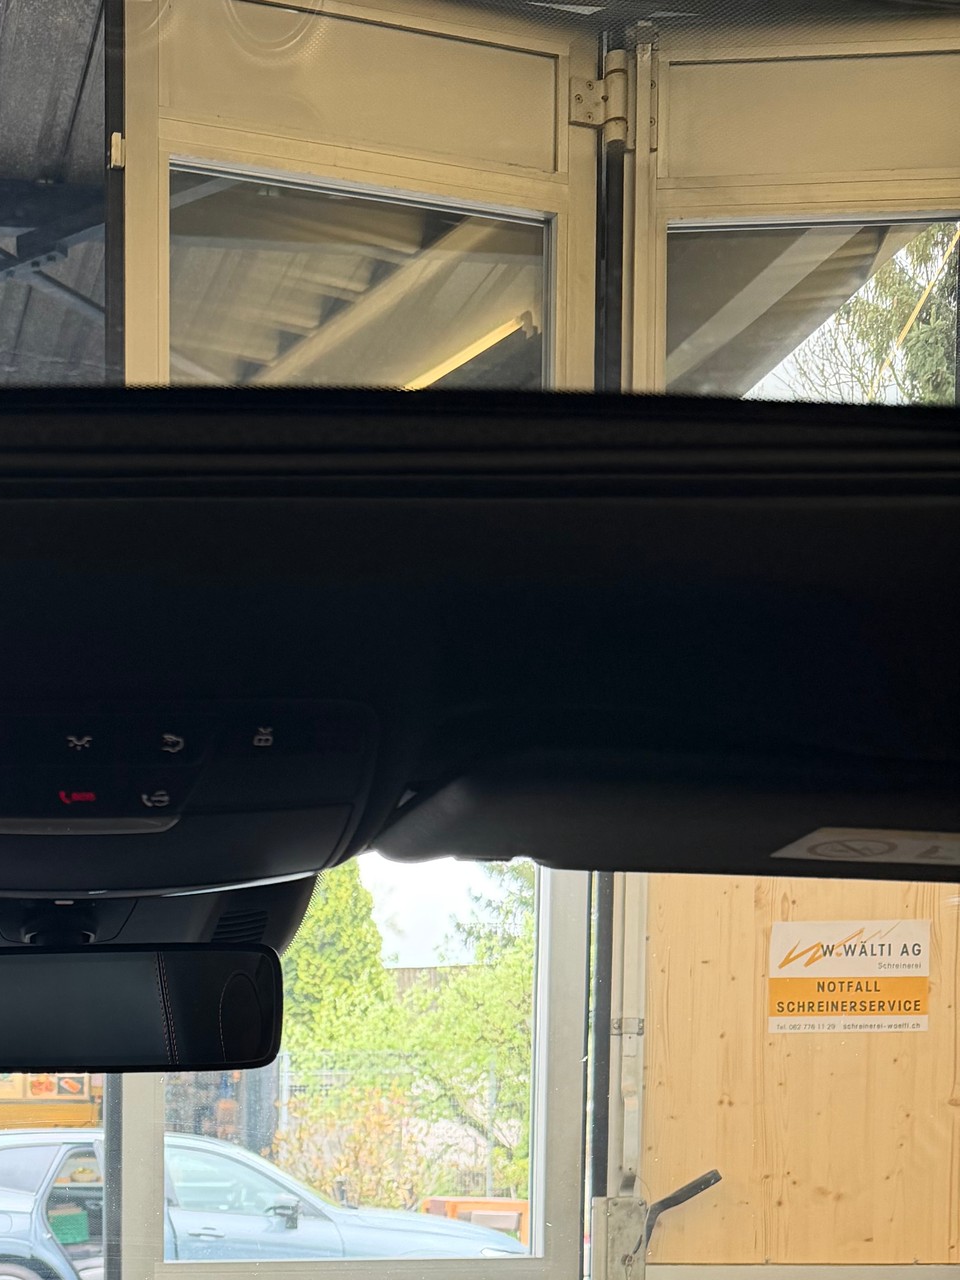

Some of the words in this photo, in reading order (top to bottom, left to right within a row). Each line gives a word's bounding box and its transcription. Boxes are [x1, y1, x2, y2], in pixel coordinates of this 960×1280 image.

[843, 940, 892, 957] WÄLTI
[900, 943, 922, 957] AG
[877, 962, 922, 970] Schreinerei
[816, 980, 881, 993] NOTFALL
[776, 999, 921, 1013] SCHREINERSERVICE
